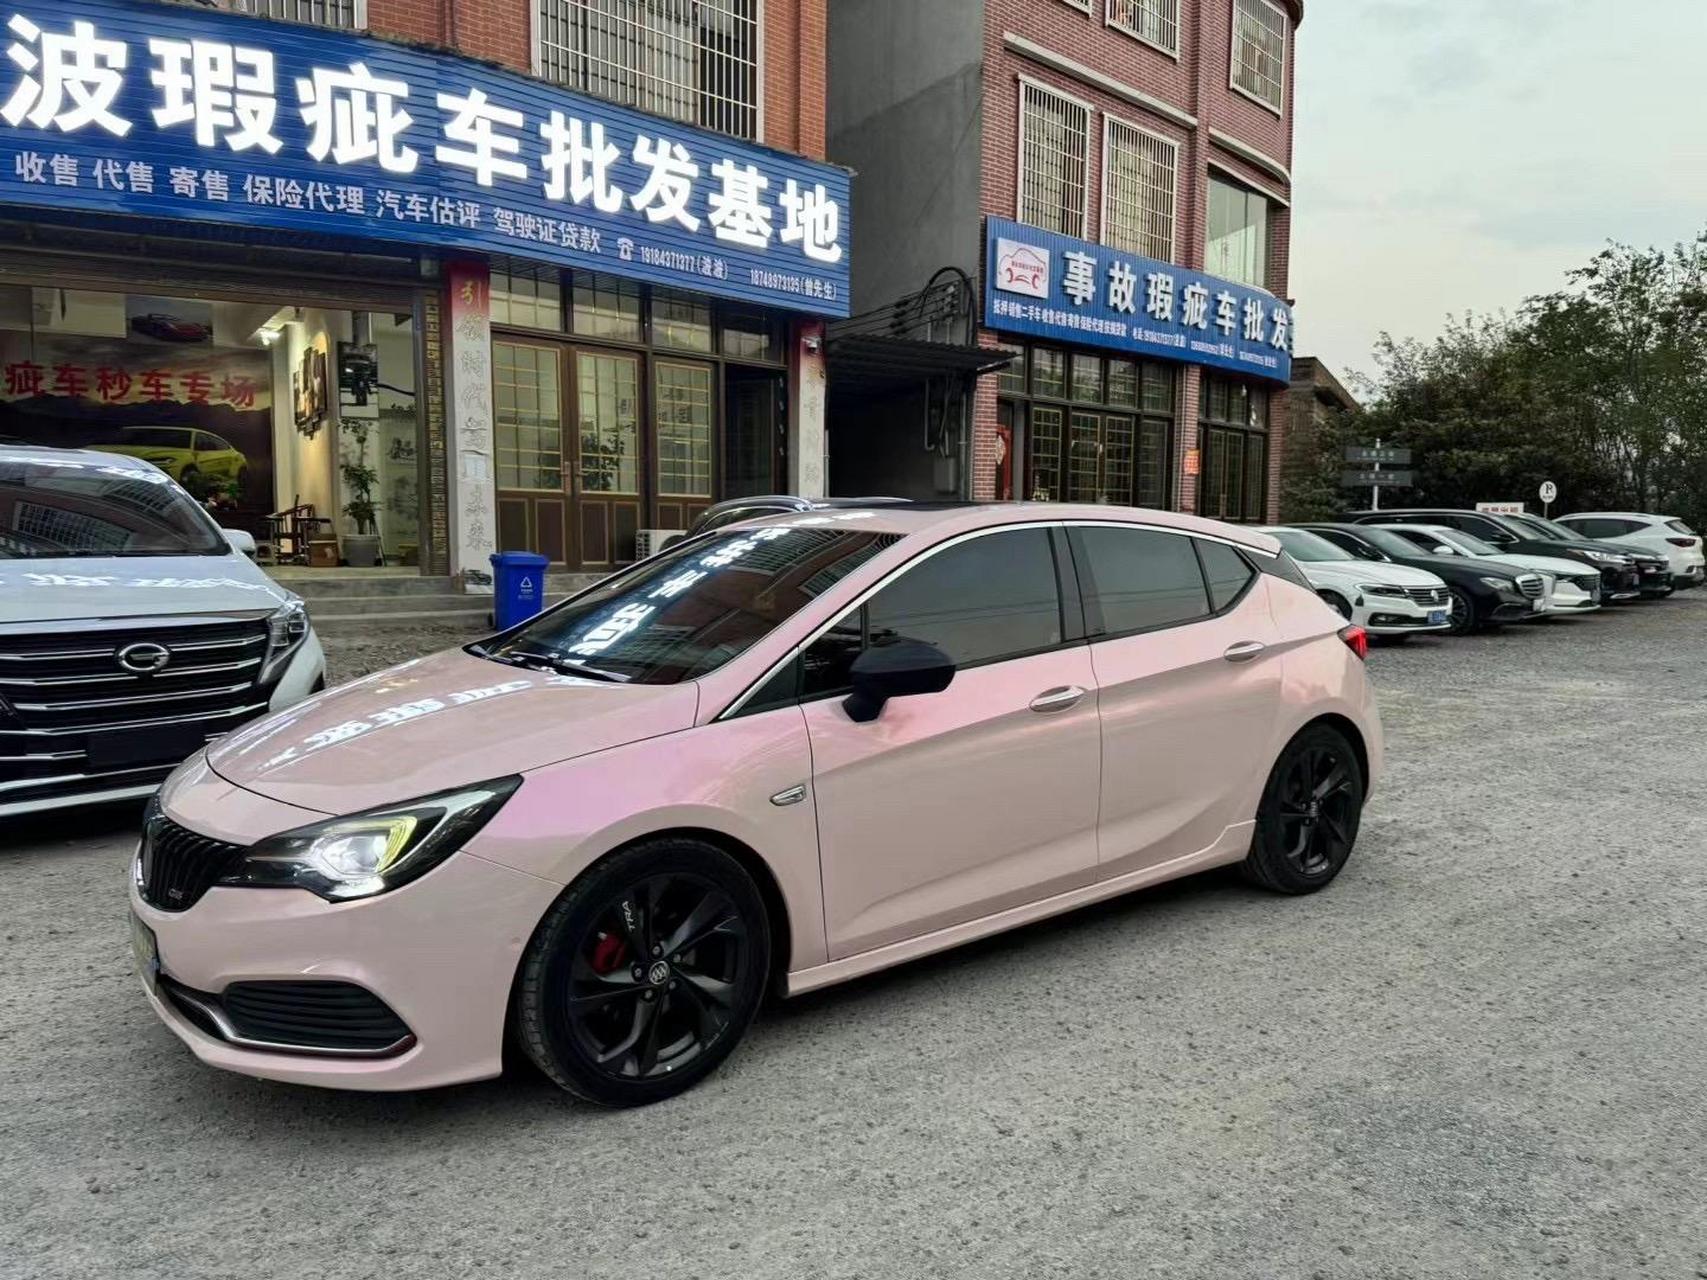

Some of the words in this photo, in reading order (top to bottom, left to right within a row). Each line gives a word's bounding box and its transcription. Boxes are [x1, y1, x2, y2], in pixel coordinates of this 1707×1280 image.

[0, 13, 842, 263] 波瑕疵车批发基地
[15, 151, 79, 187] 收售
[93, 159, 154, 194] 代售
[169, 166, 229, 202] 寄售
[243, 174, 365, 216] 保险代理
[376, 190, 481, 229] 汽车估评
[493, 208, 600, 254] 驾驶证贷款
